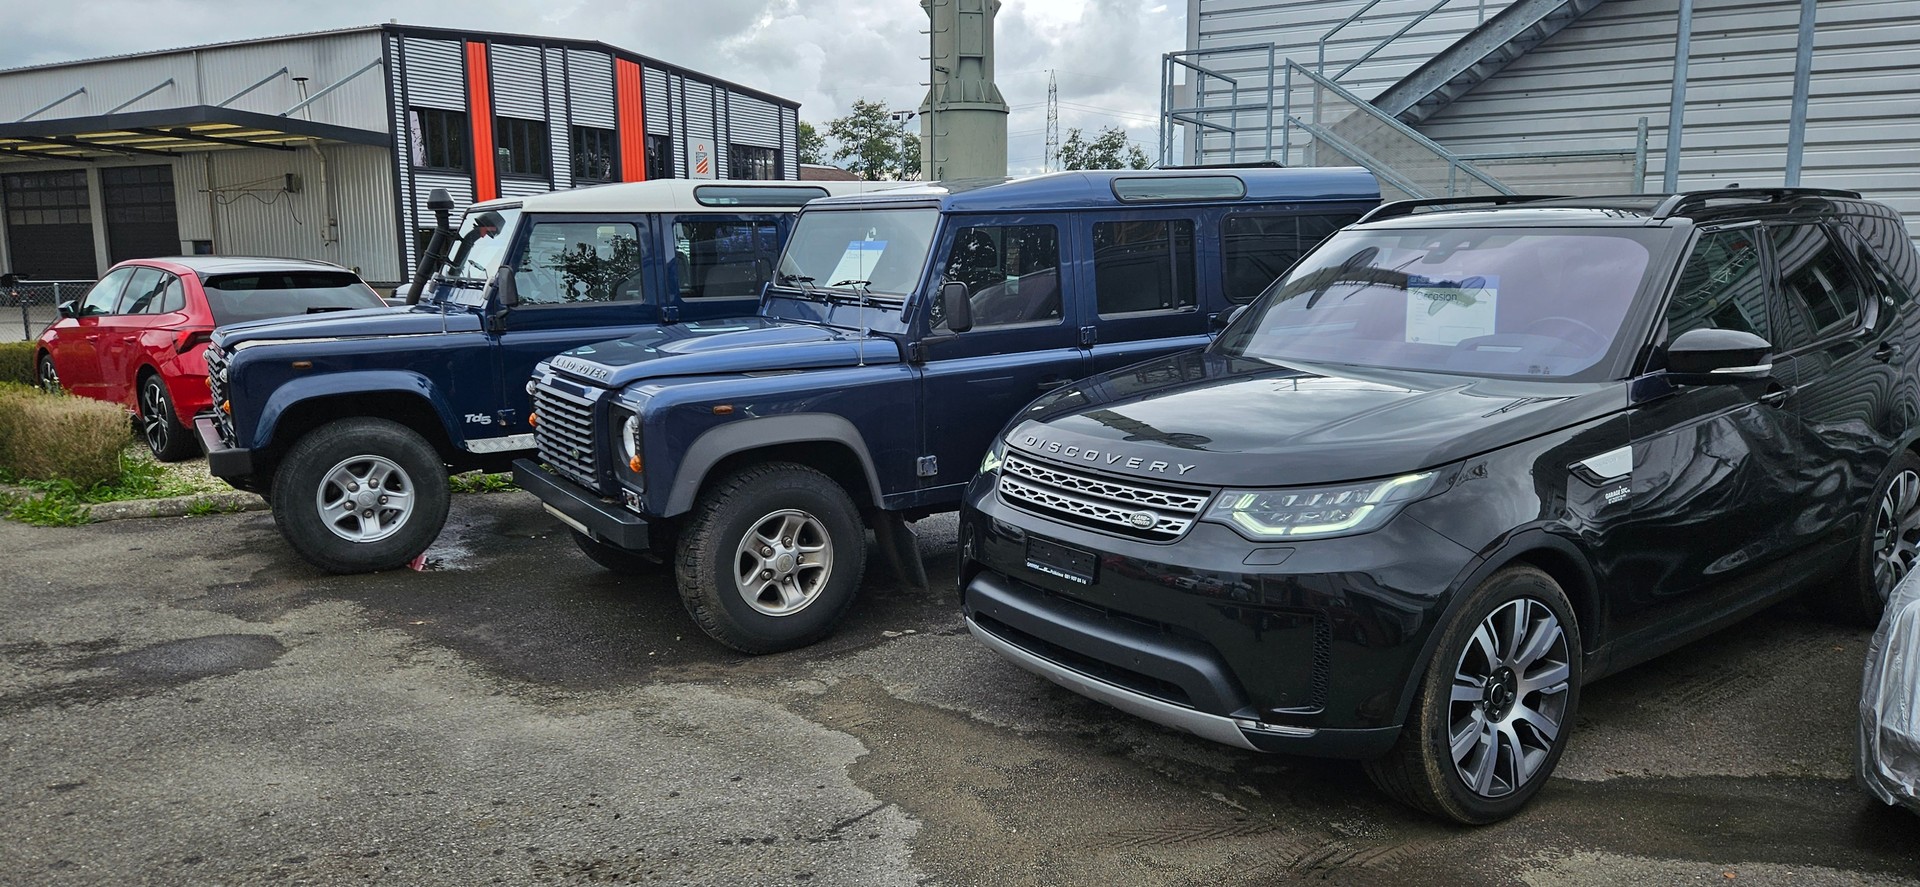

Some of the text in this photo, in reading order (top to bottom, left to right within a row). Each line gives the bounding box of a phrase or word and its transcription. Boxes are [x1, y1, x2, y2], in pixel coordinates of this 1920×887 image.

[555, 357, 608, 379] LAND ROVER
[464, 412, 492, 425] Td5
[1024, 435, 1196, 475] DISCOVERY
